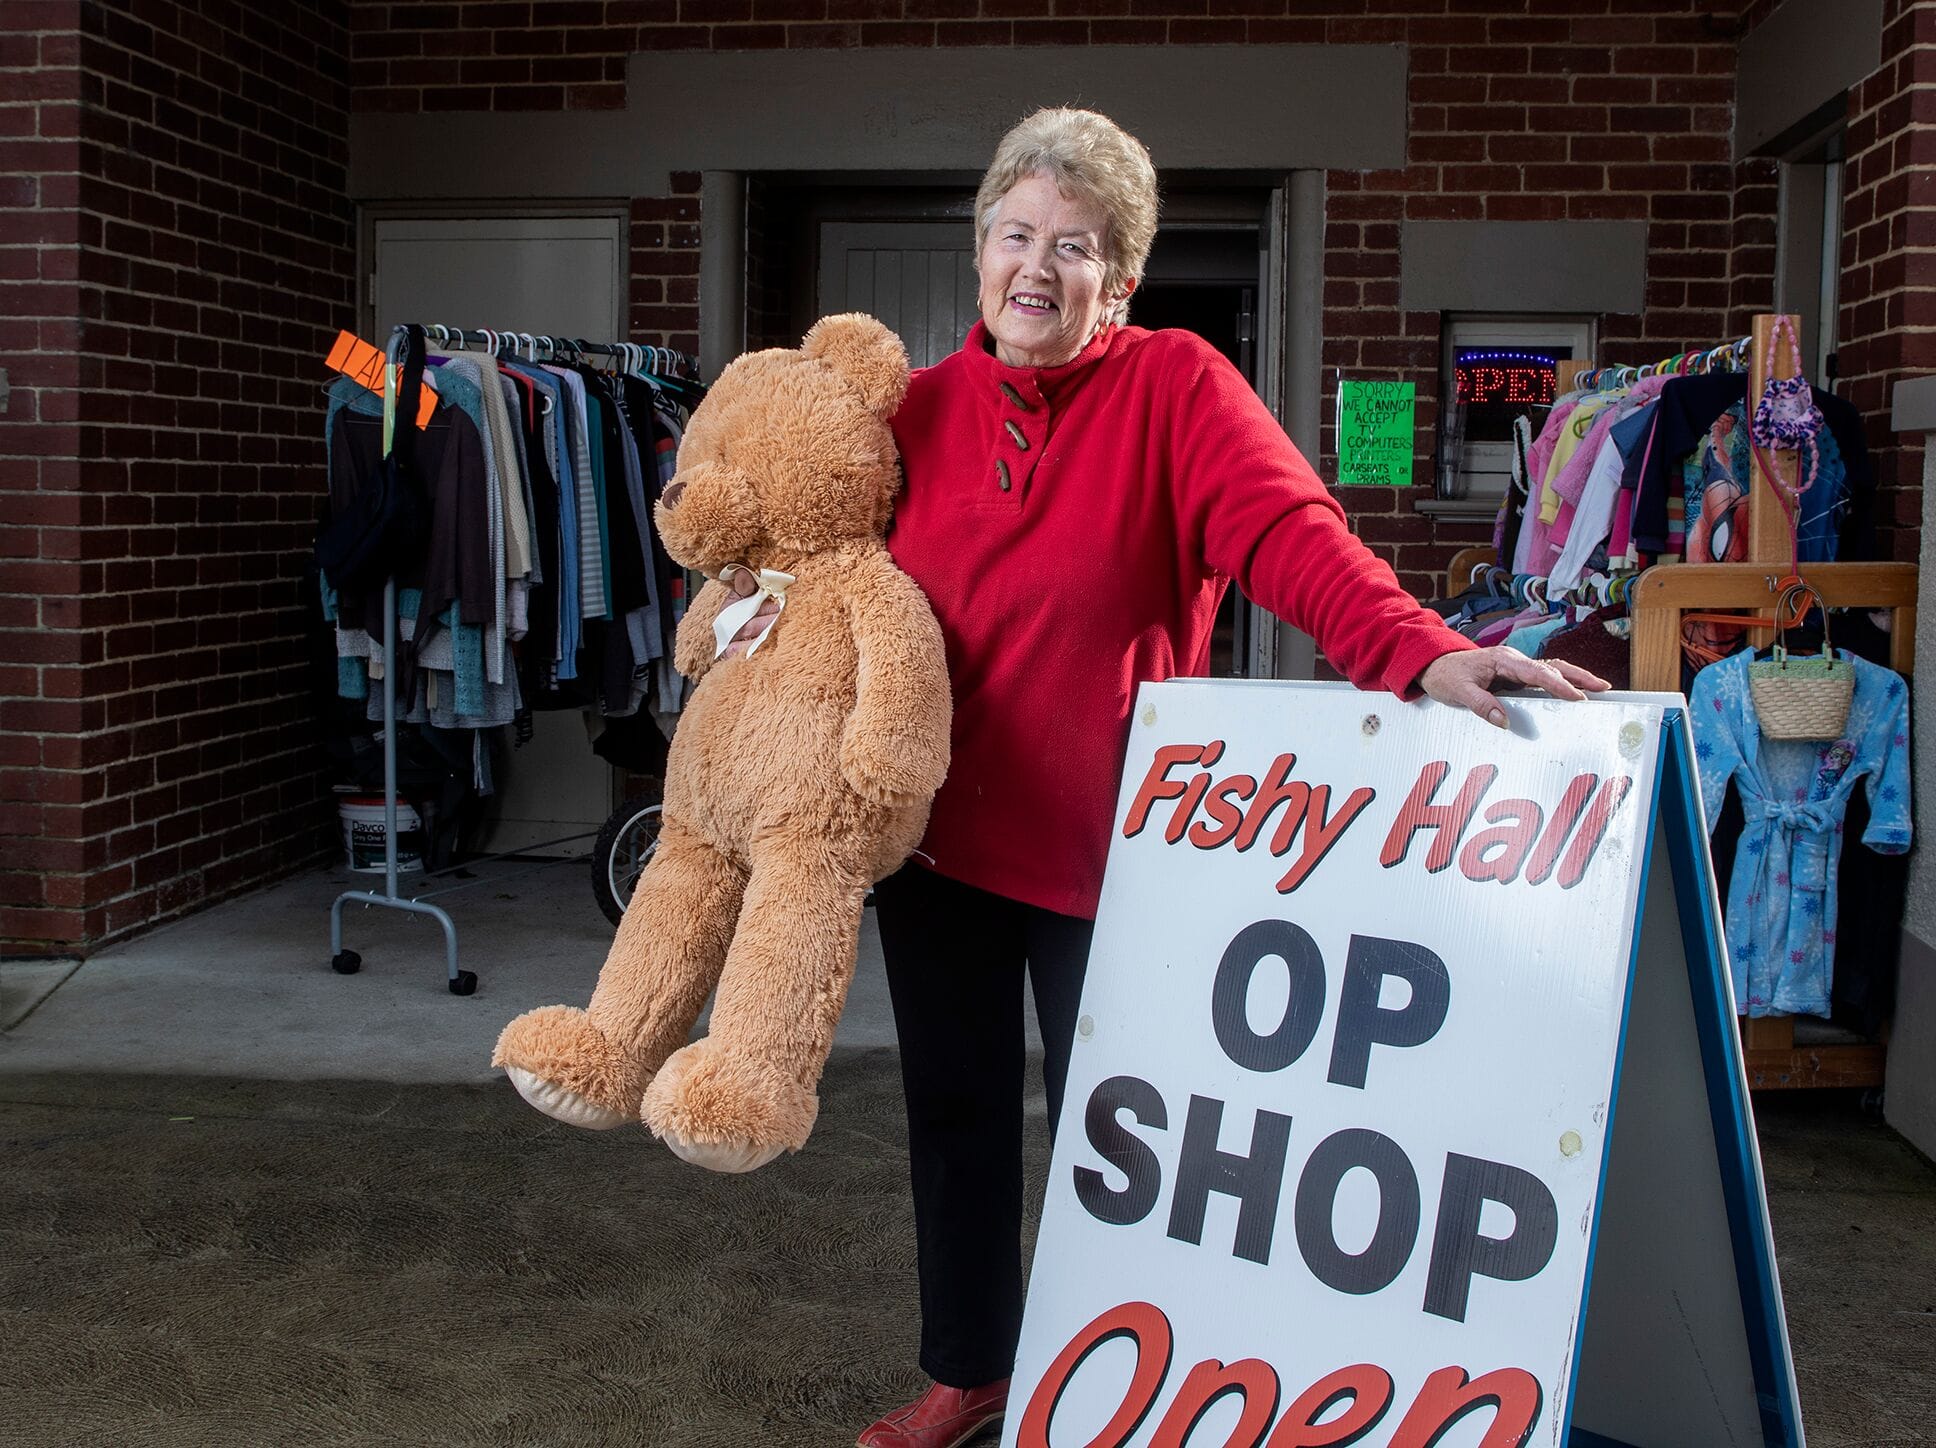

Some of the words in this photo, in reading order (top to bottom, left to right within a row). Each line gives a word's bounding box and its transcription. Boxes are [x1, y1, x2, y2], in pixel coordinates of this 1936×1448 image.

[1352, 381, 1404, 398] SORRY
[1343, 399, 1361, 411] WE
[1367, 399, 1413, 412] CANNOT
[1355, 412, 1398, 424] ACCEPT
[1347, 436, 1414, 449] COMPUTERS
[1350, 449, 1401, 461] PRINTERS
[1343, 462, 1389, 473] CARSEATS
[1357, 474, 1391, 485] PRAMS
[1122, 740, 1377, 894] Fishy
[1379, 760, 1633, 889] Hall
[352, 820, 385, 833] Davco
[1212, 918, 1451, 1090] OP
[1073, 1075, 1559, 1323] SHOP
